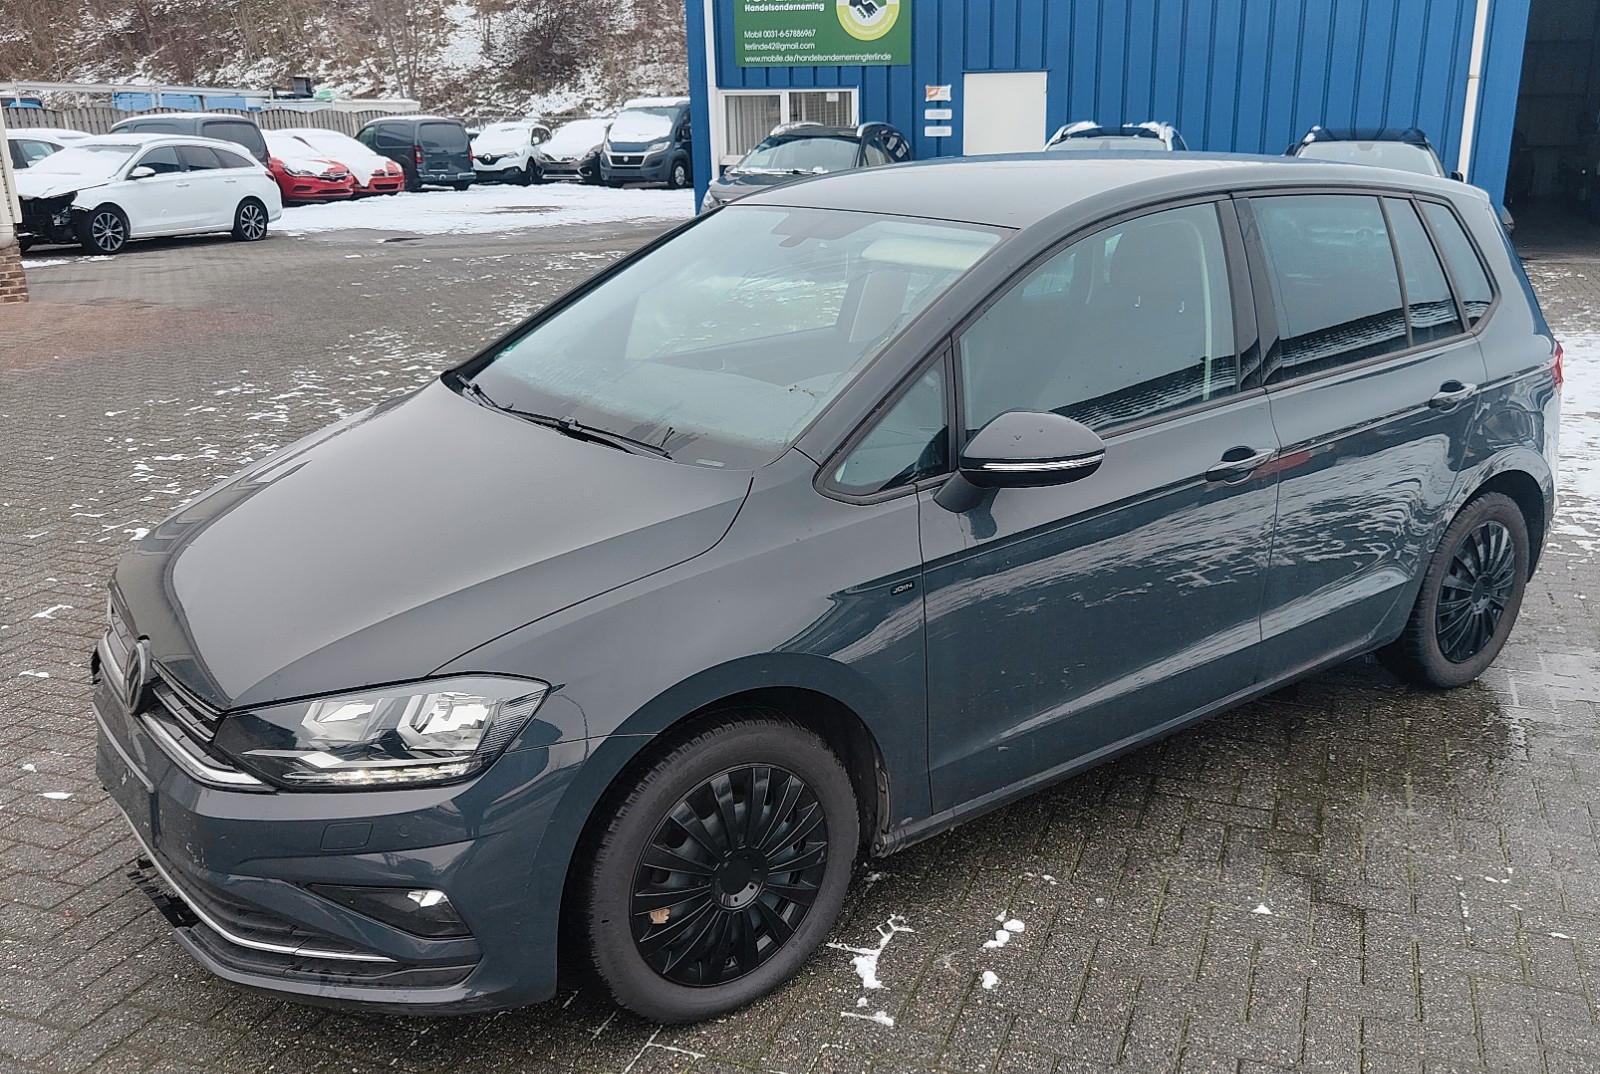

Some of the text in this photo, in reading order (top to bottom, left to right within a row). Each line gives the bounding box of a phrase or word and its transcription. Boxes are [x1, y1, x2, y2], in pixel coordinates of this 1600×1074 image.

[744, 3, 825, 12] Handelsonderneming
[744, 29, 816, 39] Mobil 0031-6-57886967
[744, 43, 815, 51] terlinde42@gmail.com
[892, 582, 913, 594] JOIN
